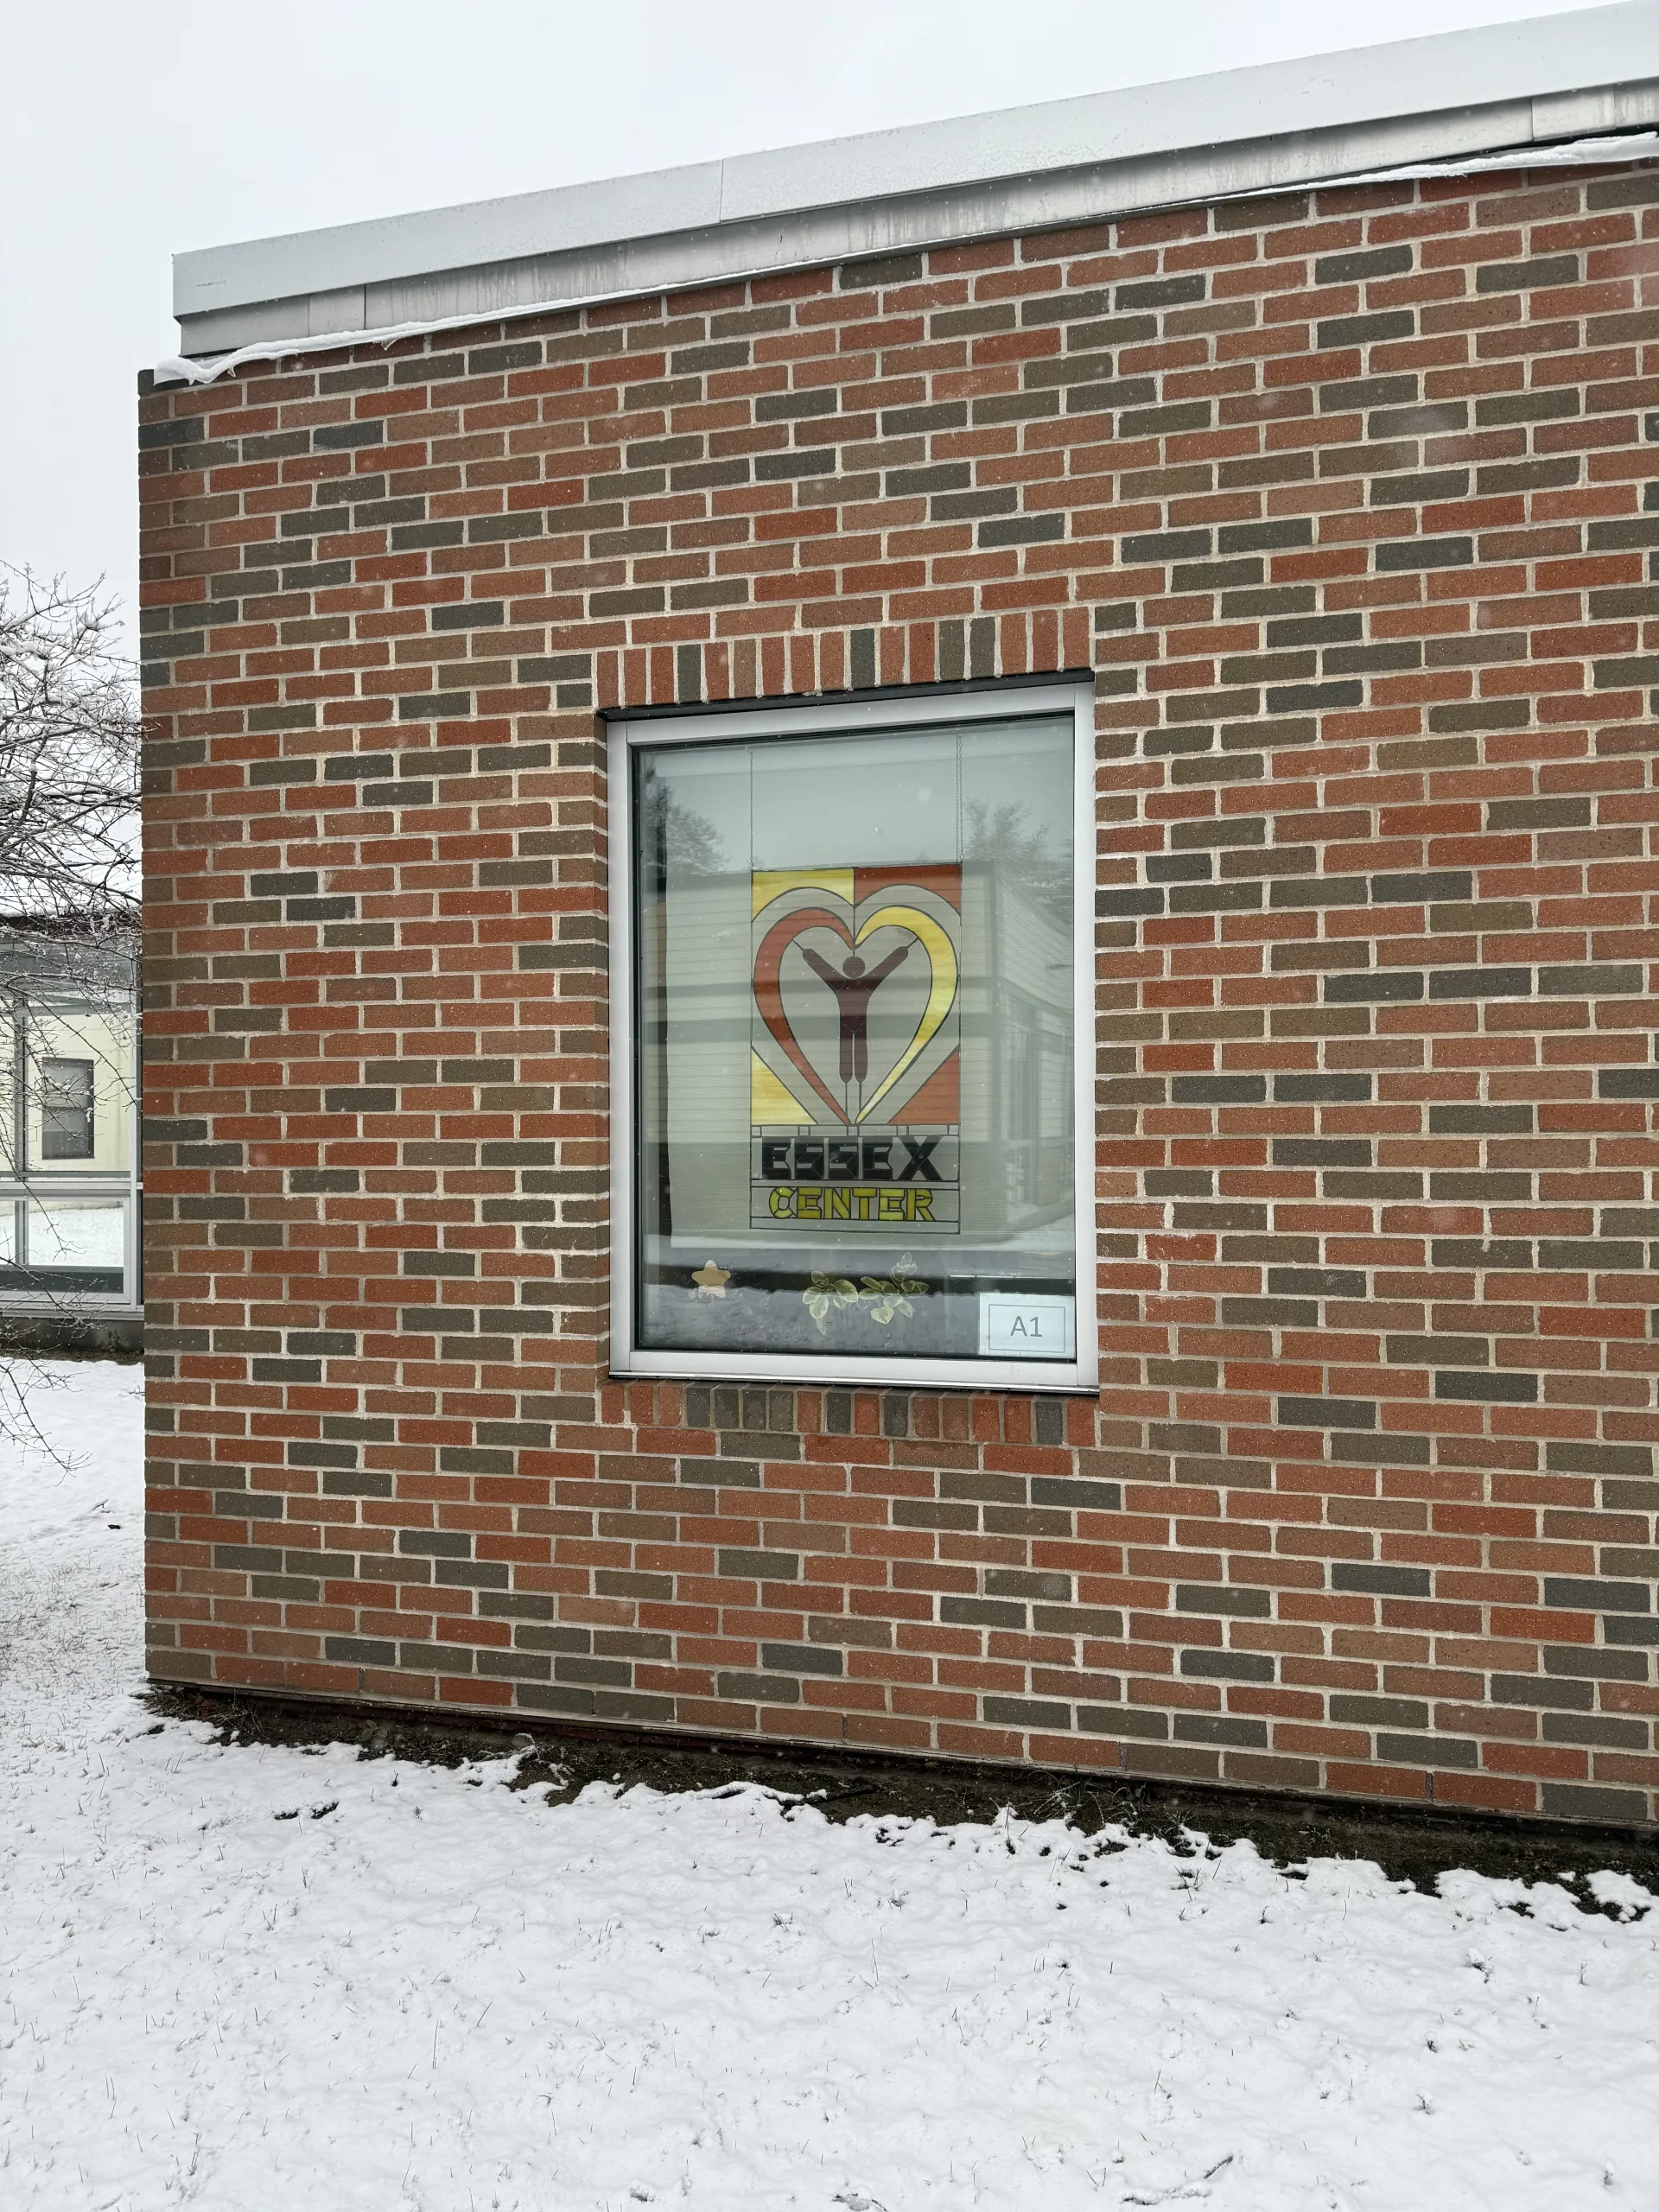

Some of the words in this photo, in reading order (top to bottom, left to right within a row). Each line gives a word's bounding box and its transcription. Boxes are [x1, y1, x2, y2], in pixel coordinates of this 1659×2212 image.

[762, 1136, 944, 1180] ESSEX
[768, 1186, 936, 1221] CENTER
[1010, 1315, 1043, 1338] A1
